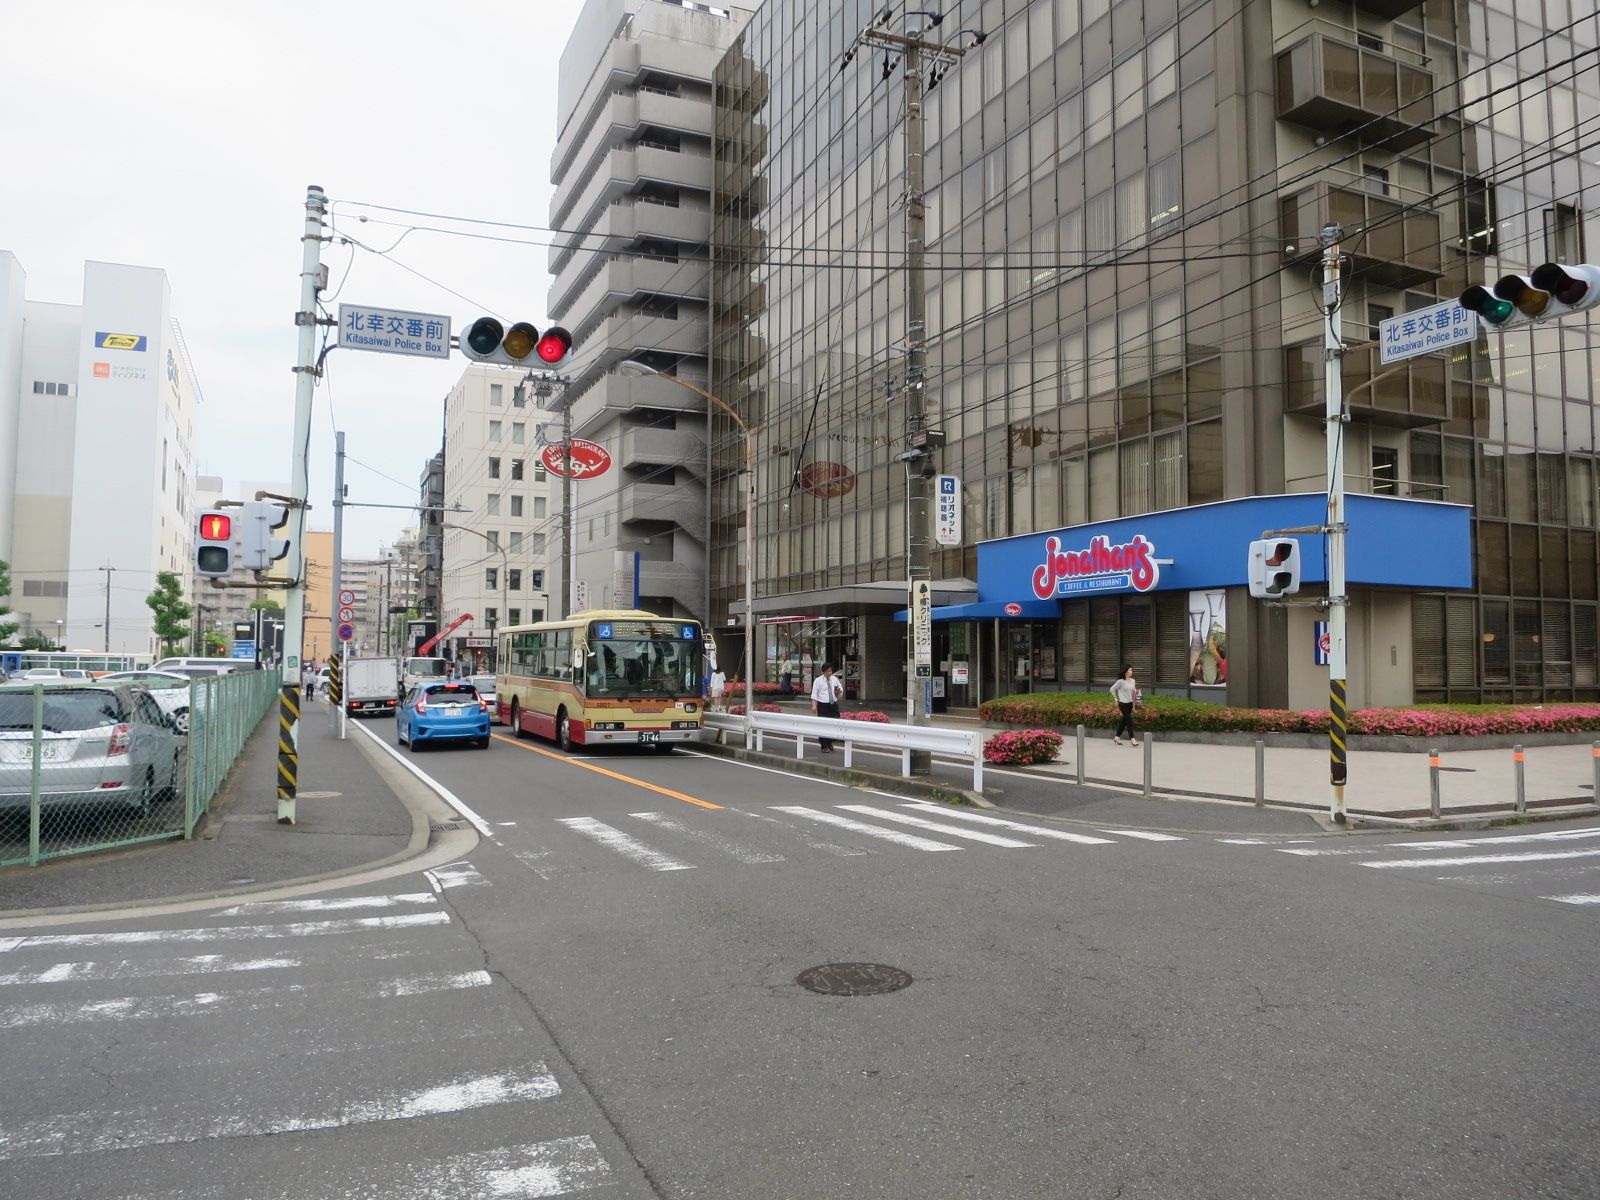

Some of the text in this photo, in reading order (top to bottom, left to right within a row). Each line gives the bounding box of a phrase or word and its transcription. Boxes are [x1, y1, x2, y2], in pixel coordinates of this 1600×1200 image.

[346, 311, 443, 339] 北幸交番前
[1386, 304, 1468, 343] 北幸交番前
[346, 332, 442, 352] Kitasaiwai Police Box
[1387, 326, 1469, 357] Kitasaiwai Police Box
[1064, 580, 1082, 591] COFFEE
[1089, 578, 1122, 588] RESTAURANT
[342, 594, 352, 602] 30
